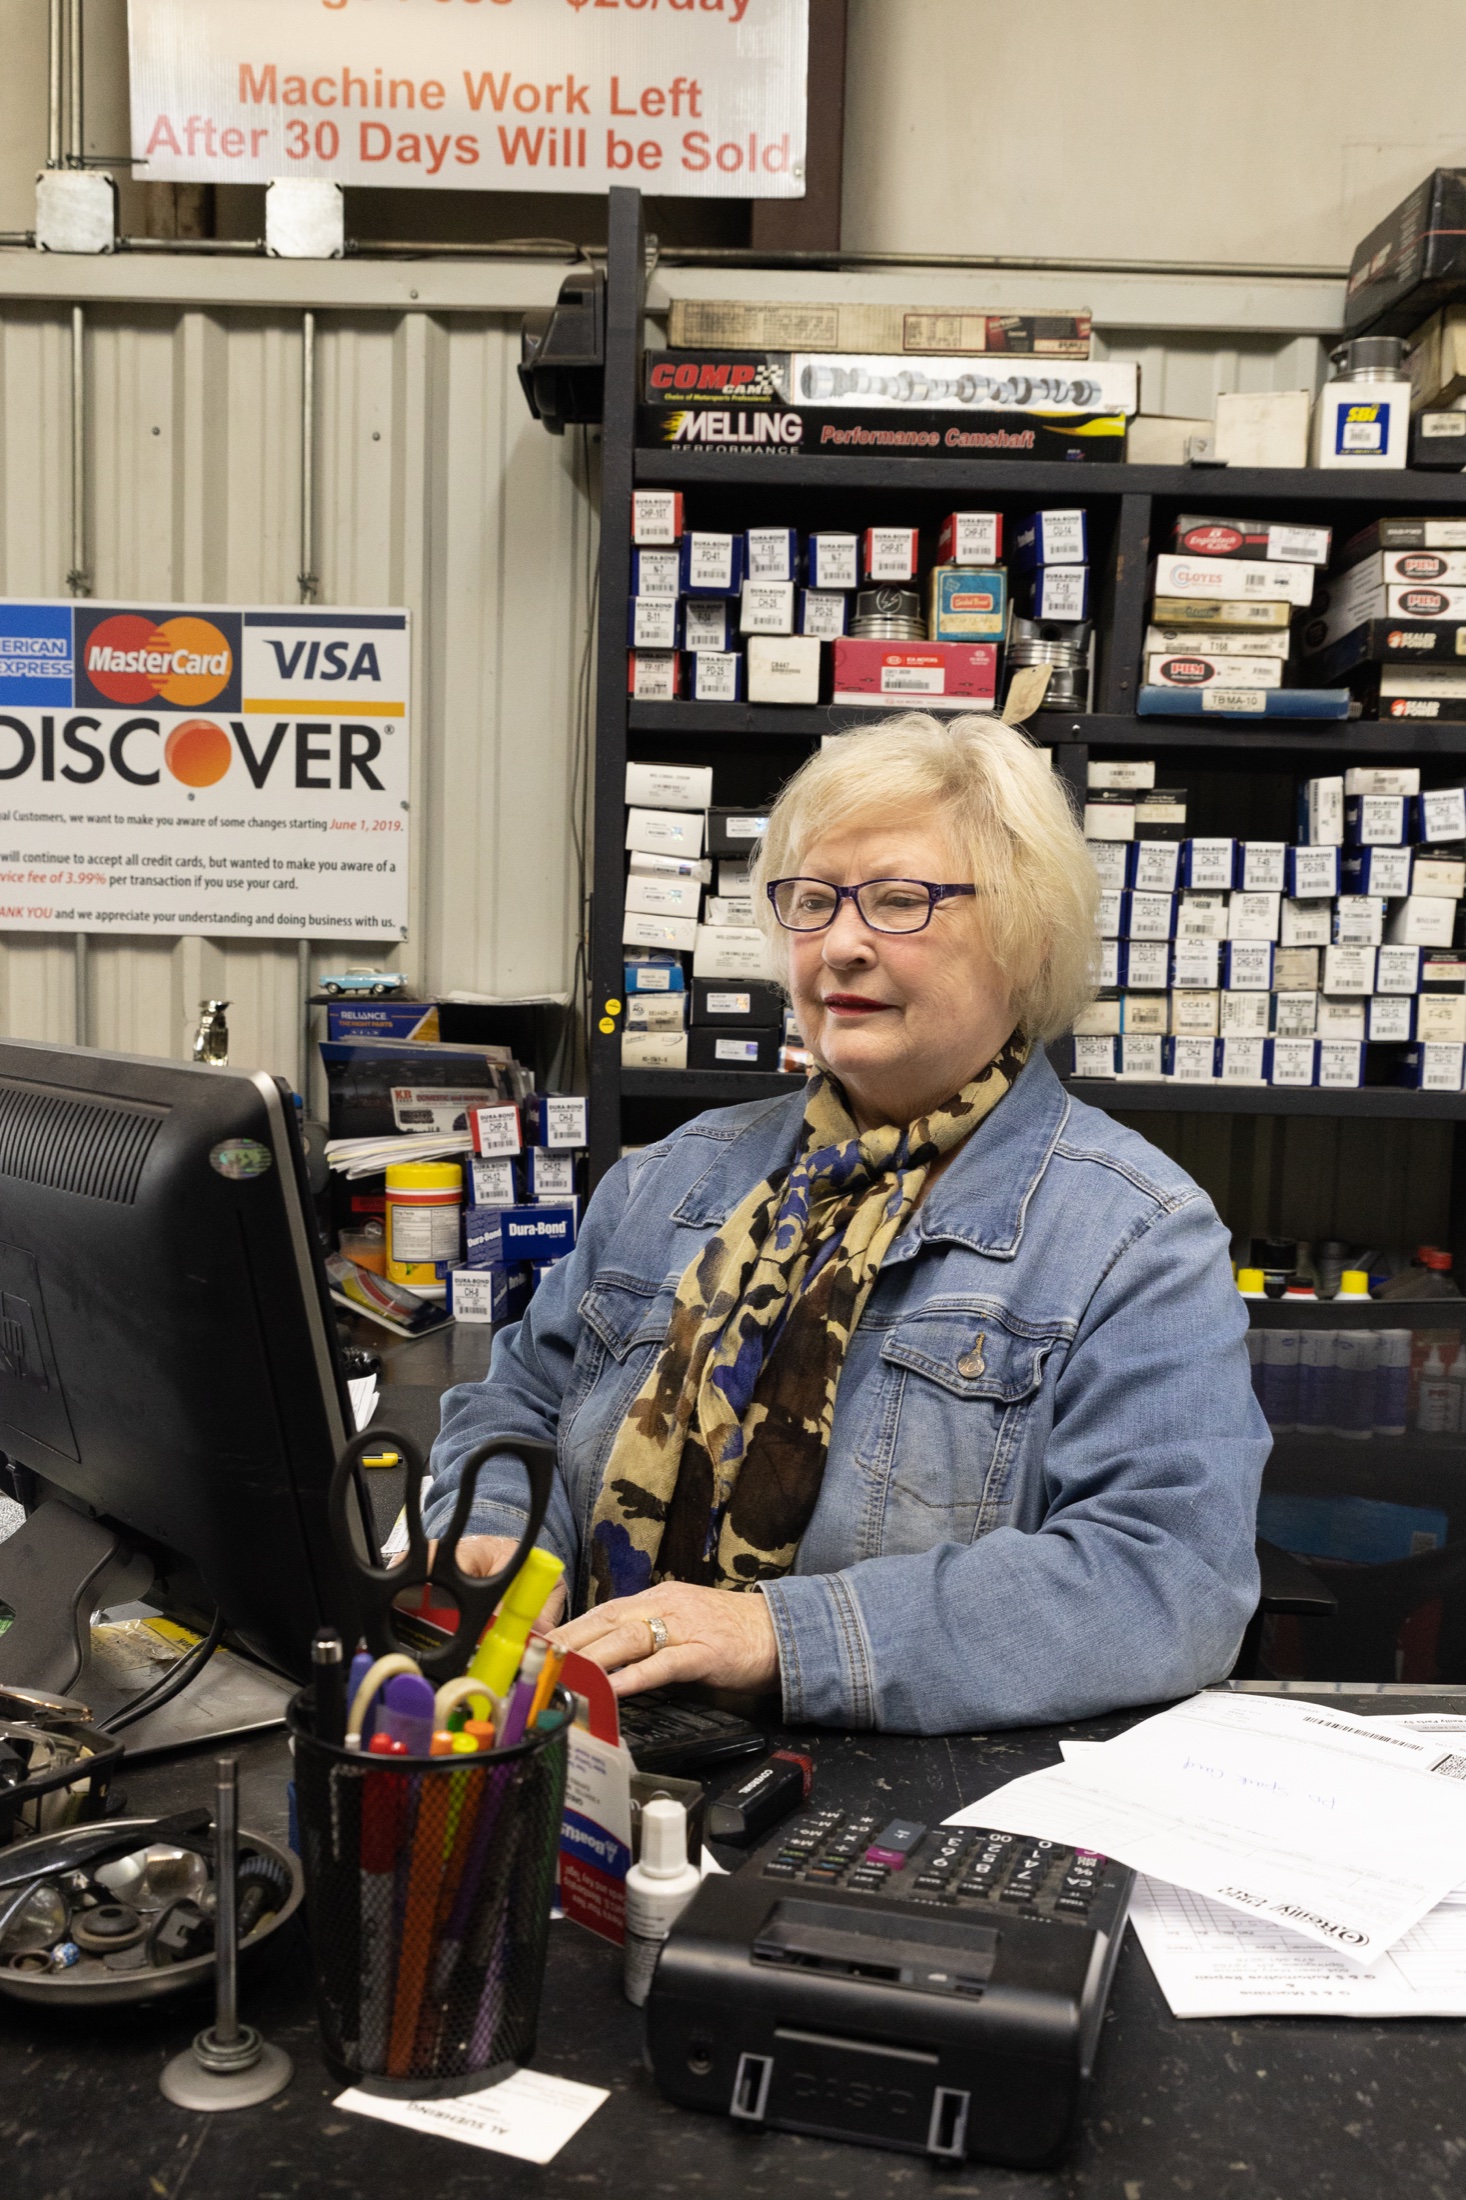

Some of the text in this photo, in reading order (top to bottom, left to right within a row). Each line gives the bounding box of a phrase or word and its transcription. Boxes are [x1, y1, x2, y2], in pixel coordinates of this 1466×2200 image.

[238, 63, 703, 118] Machine Work Left
[145, 113, 791, 175] After 30 Days Will be Sold
[650, 363, 756, 390] COMP
[722, 384, 774, 395] CAMS
[672, 410, 803, 443] MELLING
[819, 424, 1037, 450] Performance Camshaft
[671, 444, 800, 456] PERFORMANCE
[1178, 571, 1223, 584] CLOYES
[0, 638, 66, 656] ERICAN
[88, 646, 229, 676] MasterCard
[262, 639, 382, 682] VISA
[0, 810, 11, 821] al
[13, 811, 66, 824] Customers,
[69, 814, 84, 823] we
[86, 813, 112, 824] want
[114, 814, 125, 824] to
[127, 813, 153, 826] make
[155, 816, 174, 828] you
[176, 817, 206, 827] aware
[208, 815, 218, 827] of
[219, 818, 245, 828] some
[248, 816, 287, 831] changes
[289, 818, 328, 832] starting
[329, 818, 357, 831] June
[1, 851, 396, 873] will continue to accept all credit cards, but wanted to make you aware of a
[27, 870, 46, 883] fee
[49, 871, 64, 884] of
[65, 871, 107, 885] 3.99%
[109, 876, 127, 888] per
[130, 875, 192, 887] transaction
[194, 875, 202, 887] if
[204, 878, 223, 890] you
[226, 878, 244, 888] use
[246, 879, 271, 891] your
[272, 877, 299, 890] card.
[27, 906, 53, 919] YOU
[55, 908, 75, 920] and
[77, 911, 92, 920] we
[95, 908, 150, 923] appreciate
[152, 912, 176, 924] your
[178, 911, 253, 926] understanding
[255, 912, 275, 925] and
[277, 913, 306, 928] doing
[308, 914, 353, 927] business
[355, 914, 379, 927] with
[381, 917, 396, 928] us.
[340, 1011, 387, 1020] RELIANCE
[394, 1089, 412, 1100] KB
[467, 1227, 502, 1248] Dura-Bond
[508, 1221, 567, 1237] Dura-Bond
[738, 1768, 773, 1795] COVERGIRL
[1275, 1903, 1370, 1948] O'Reilly
